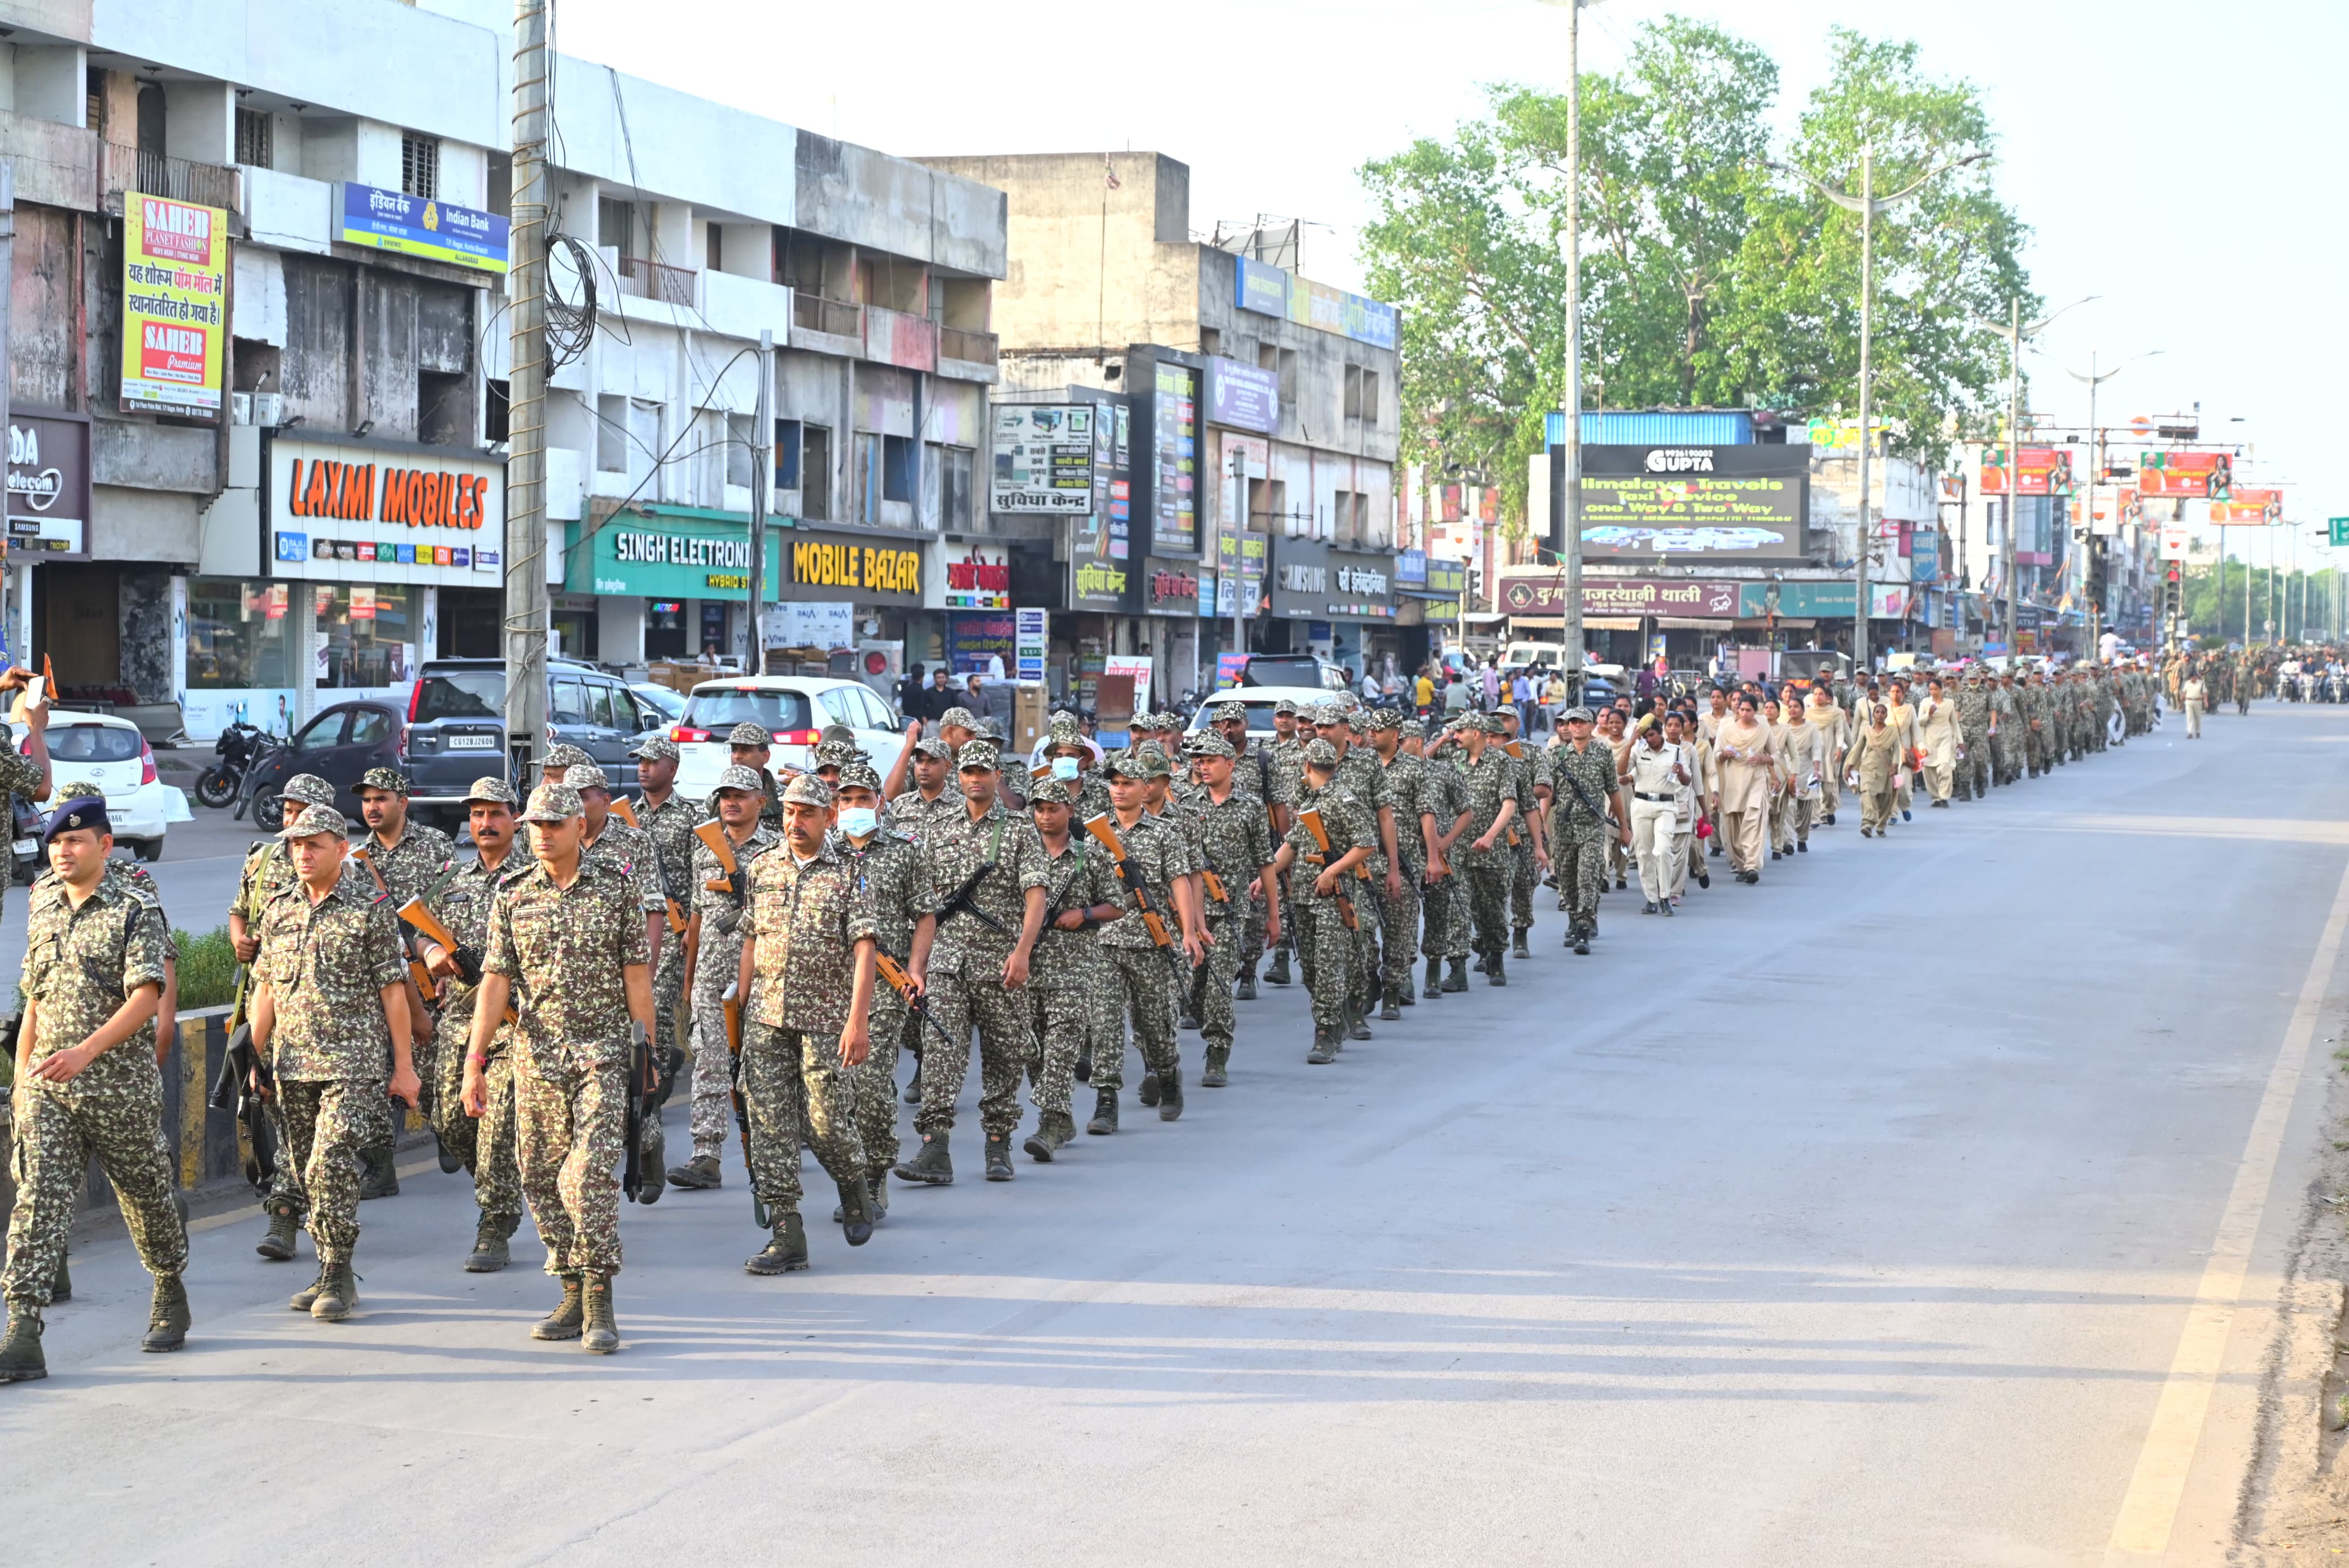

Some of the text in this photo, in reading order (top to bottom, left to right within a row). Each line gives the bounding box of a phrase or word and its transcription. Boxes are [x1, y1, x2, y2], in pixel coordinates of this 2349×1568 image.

[370, 189, 411, 214] इंडियन बैंक
[145, 201, 208, 239] SAHEB
[446, 208, 489, 232] Indian Bank
[146, 232, 207, 252] PLANET FASHION
[164, 248, 174, 256] WEAR
[189, 252, 199, 261] WEAR
[455, 254, 478, 264] ALLAHABAD
[129, 264, 143, 283] यह
[145, 261, 172, 287] शोरूम
[194, 270, 213, 294] मॉल
[214, 273, 222, 295] में
[129, 292, 177, 318] स्थानांतरित
[179, 296, 189, 320] हो
[191, 304, 208, 323] गया
[145, 325, 203, 356] SAHEB
[167, 355, 202, 370] Premium
[8, 425, 38, 466] DA
[1647, 449, 1714, 472] GUPTA
[8, 470, 53, 491] elecom
[1696, 477, 1783, 491] Travels
[290, 458, 487, 529] LAXMI MOBILES
[996, 492, 1086, 509] सुविधा केन्द्र
[1617, 490, 1655, 501] Taxi
[1586, 503, 1773, 515] one Way & Two Way
[15, 523, 39, 532] SAMSUNG
[49, 541, 69, 550] realme
[289, 539, 305, 547] BAJAJ
[317, 543, 333, 552] iPhone
[617, 533, 766, 569] SINGH ELECTRONIS
[1914, 533, 1935, 550] दवाई
[794, 541, 919, 595] MOBILE BAZAR
[709, 574, 737, 588] HYBRID
[1076, 563, 1127, 599] सुविधा केन्द्र
[1152, 569, 1180, 603] सुविधा
[1281, 564, 1325, 593] SAMSUNG
[1661, 584, 1701, 602] थाली
[453, 737, 493, 746] CG12BJ2606
